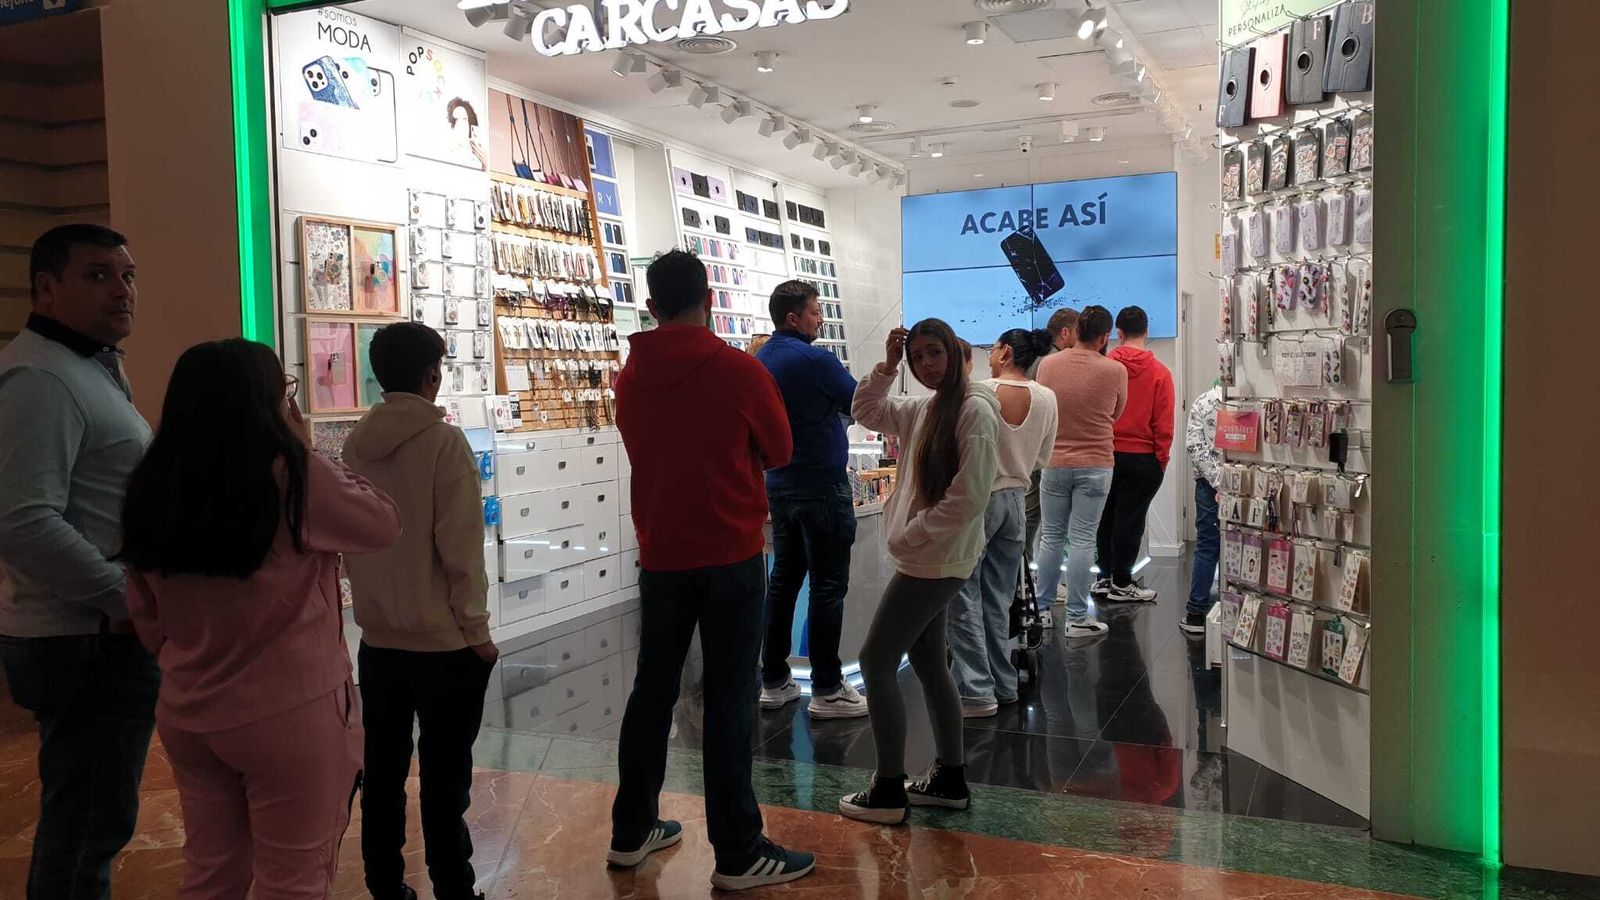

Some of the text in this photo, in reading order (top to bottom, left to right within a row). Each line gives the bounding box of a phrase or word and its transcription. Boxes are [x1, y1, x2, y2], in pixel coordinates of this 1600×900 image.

[1228, 4, 1286, 37] PERSONALIZA
[1361, 4, 1373, 25] B
[317, 21, 372, 53] MODA
[1312, 20, 1323, 40] F
[961, 191, 1108, 236] ACABE ASÍ
[1231, 501, 1240, 520] A
